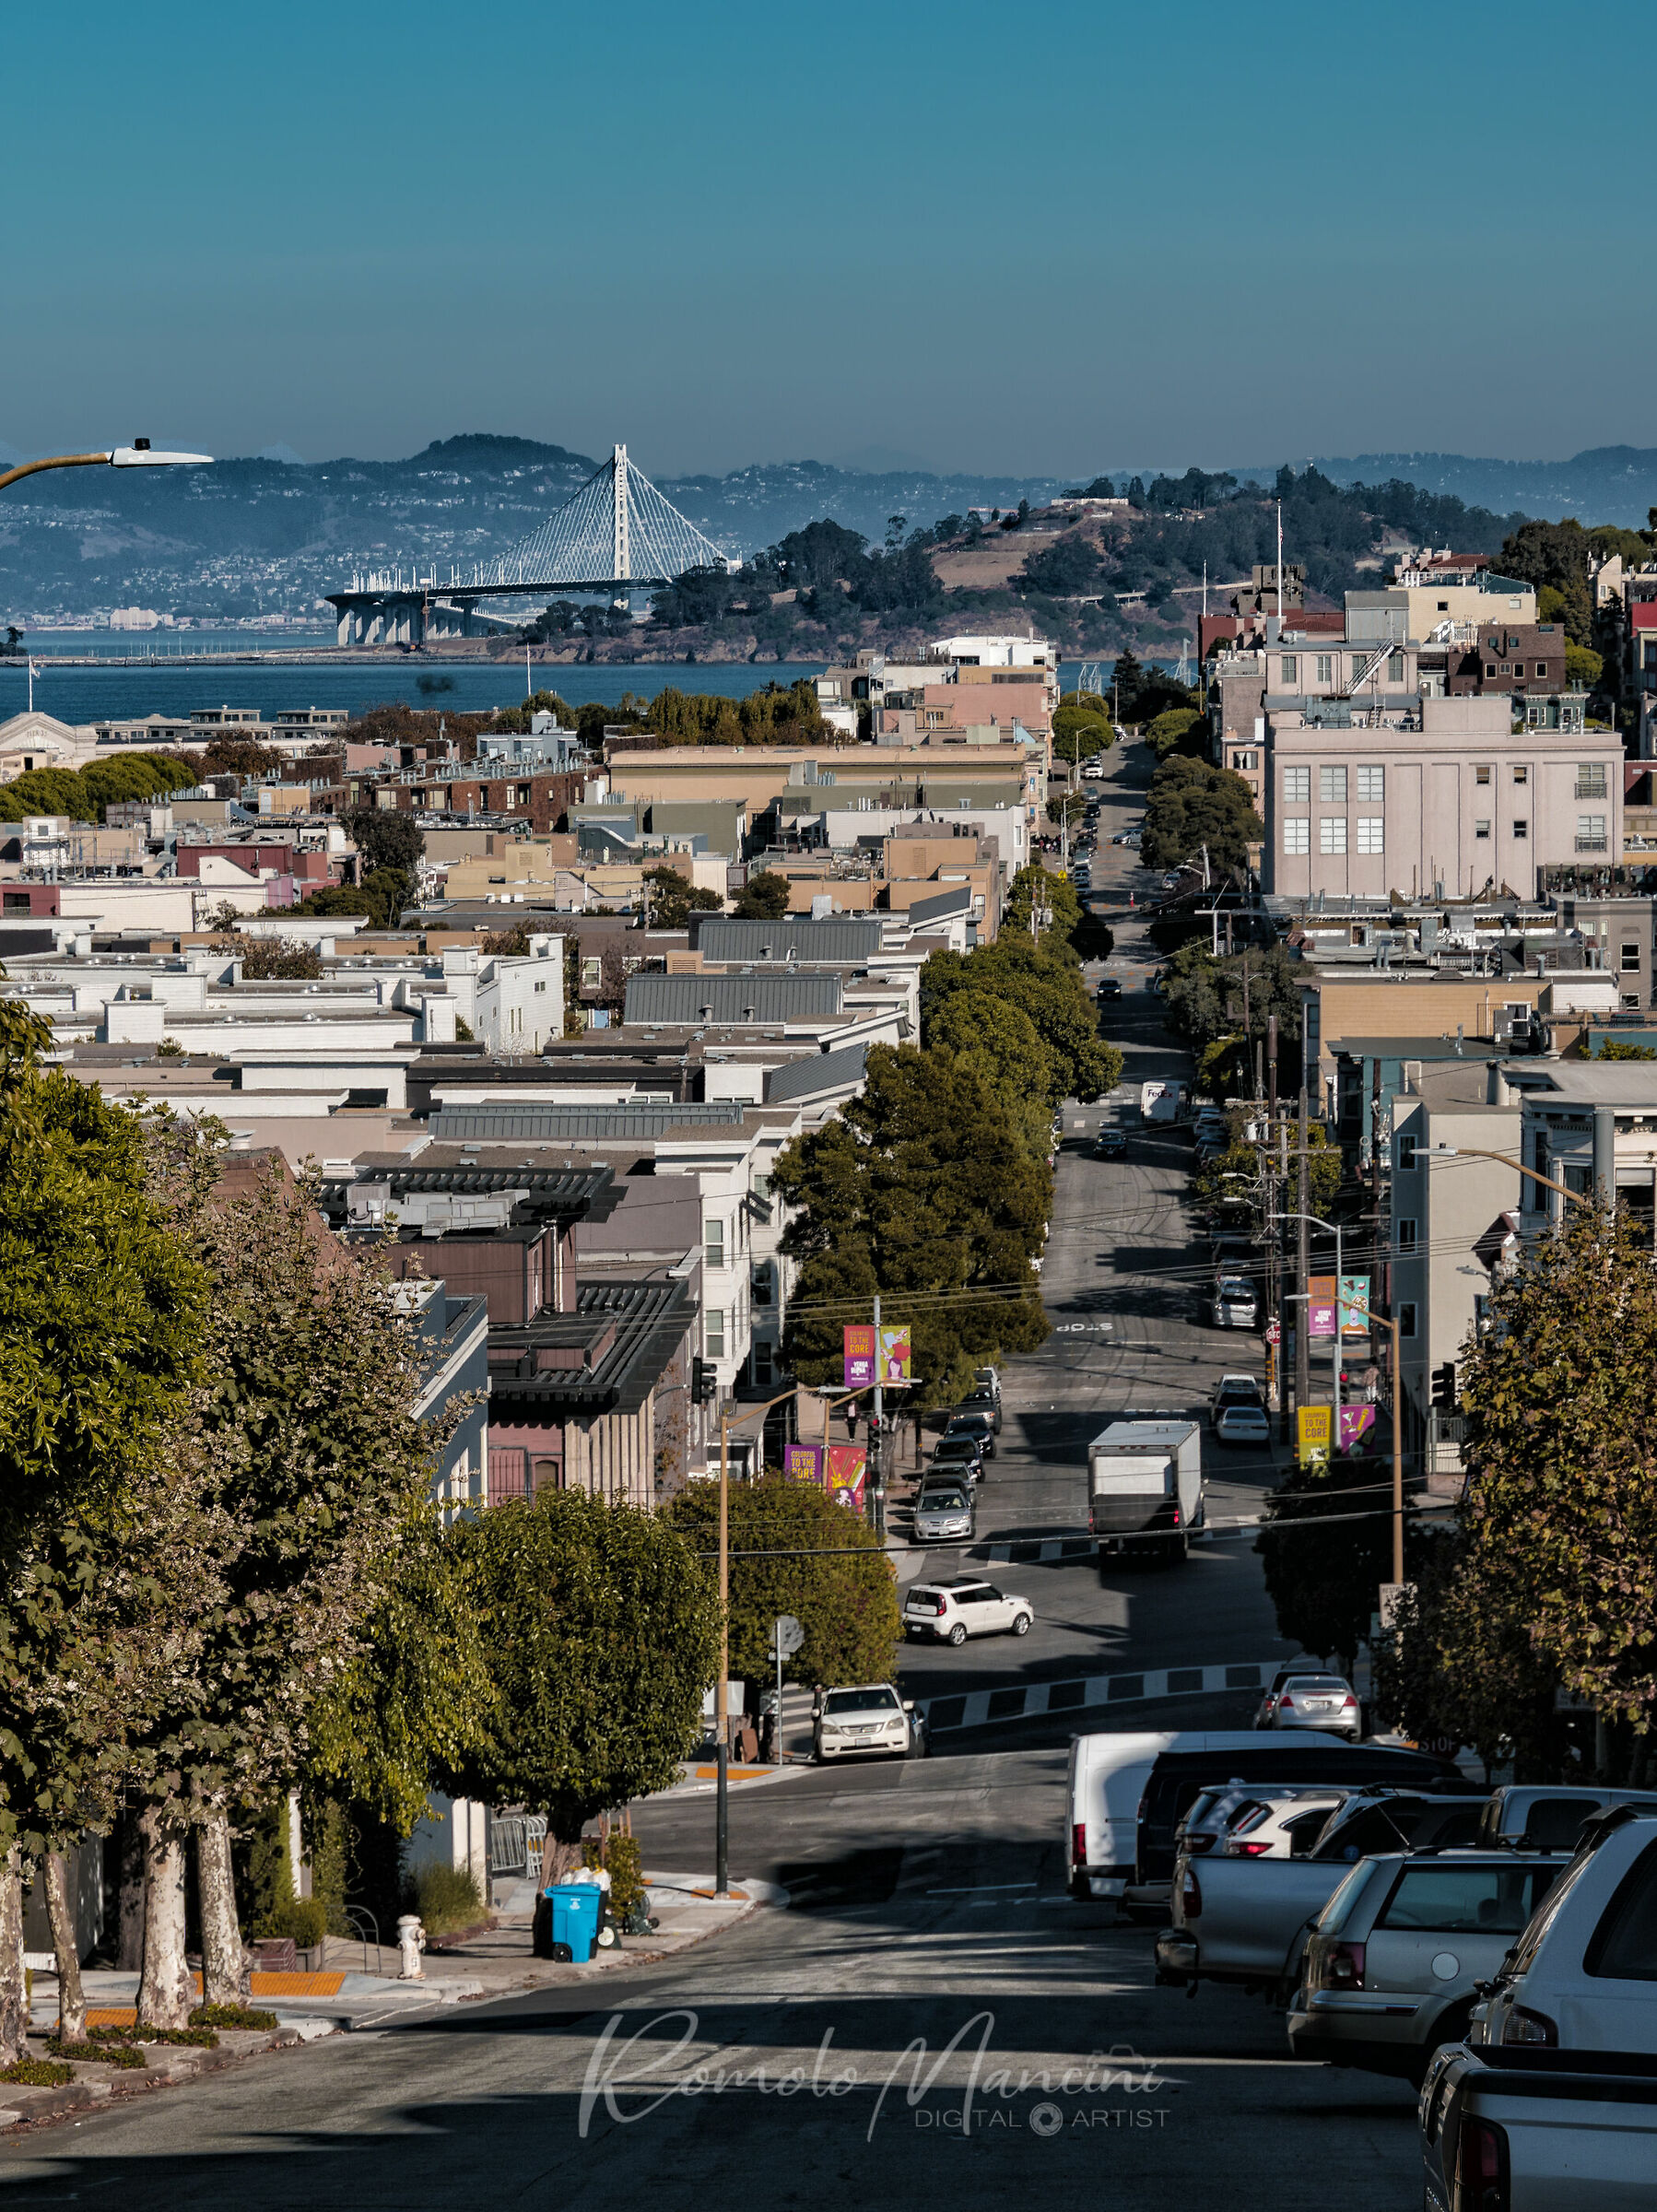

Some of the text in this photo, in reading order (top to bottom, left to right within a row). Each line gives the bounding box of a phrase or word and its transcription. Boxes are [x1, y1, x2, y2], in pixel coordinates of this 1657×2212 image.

[1147, 1088, 1173, 1099] FedEx
[1056, 1322, 1113, 1332] STOP
[850, 1344, 869, 1354] CORE
[1305, 1419, 1313, 1428] TO
[1305, 1428, 1327, 1438] CORE
[792, 1458, 816, 1467] TO THE
